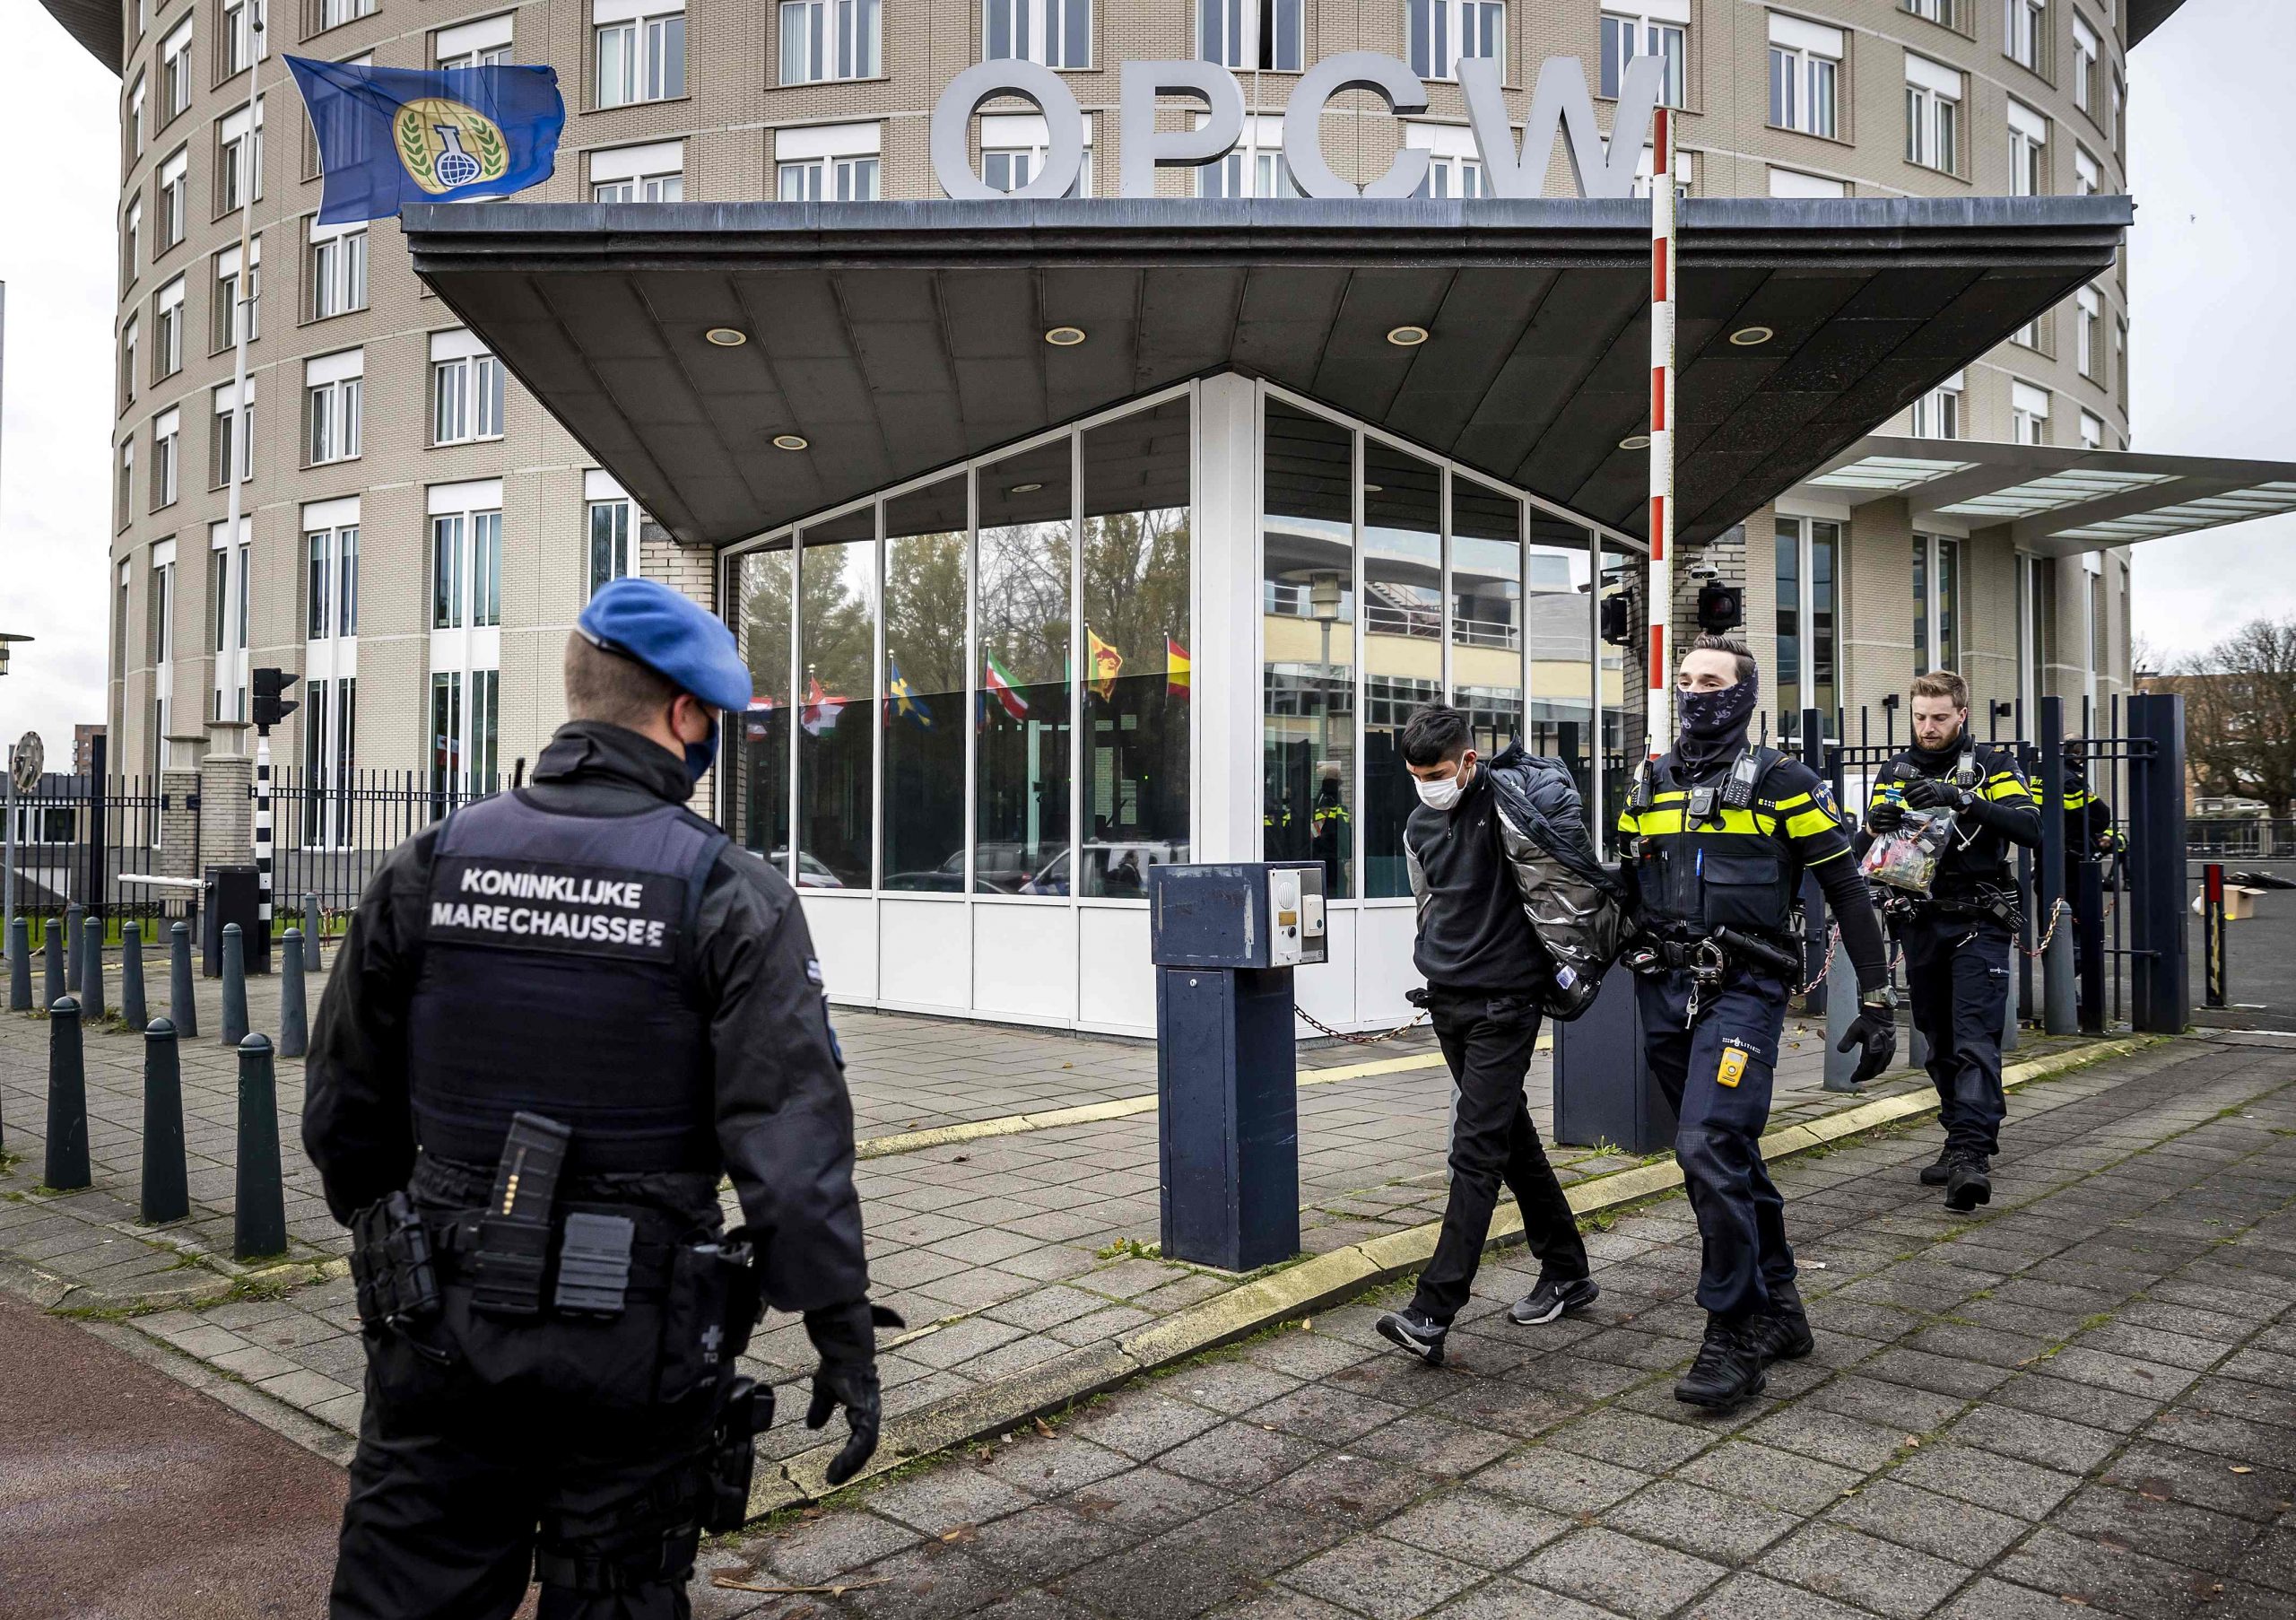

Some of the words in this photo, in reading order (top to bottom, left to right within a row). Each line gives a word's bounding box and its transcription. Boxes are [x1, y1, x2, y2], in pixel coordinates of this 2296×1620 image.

[931, 52, 1667, 198] OPCW
[461, 868, 643, 909] KONINKLIJKE
[430, 902, 665, 947] MARECHAUSSEE
